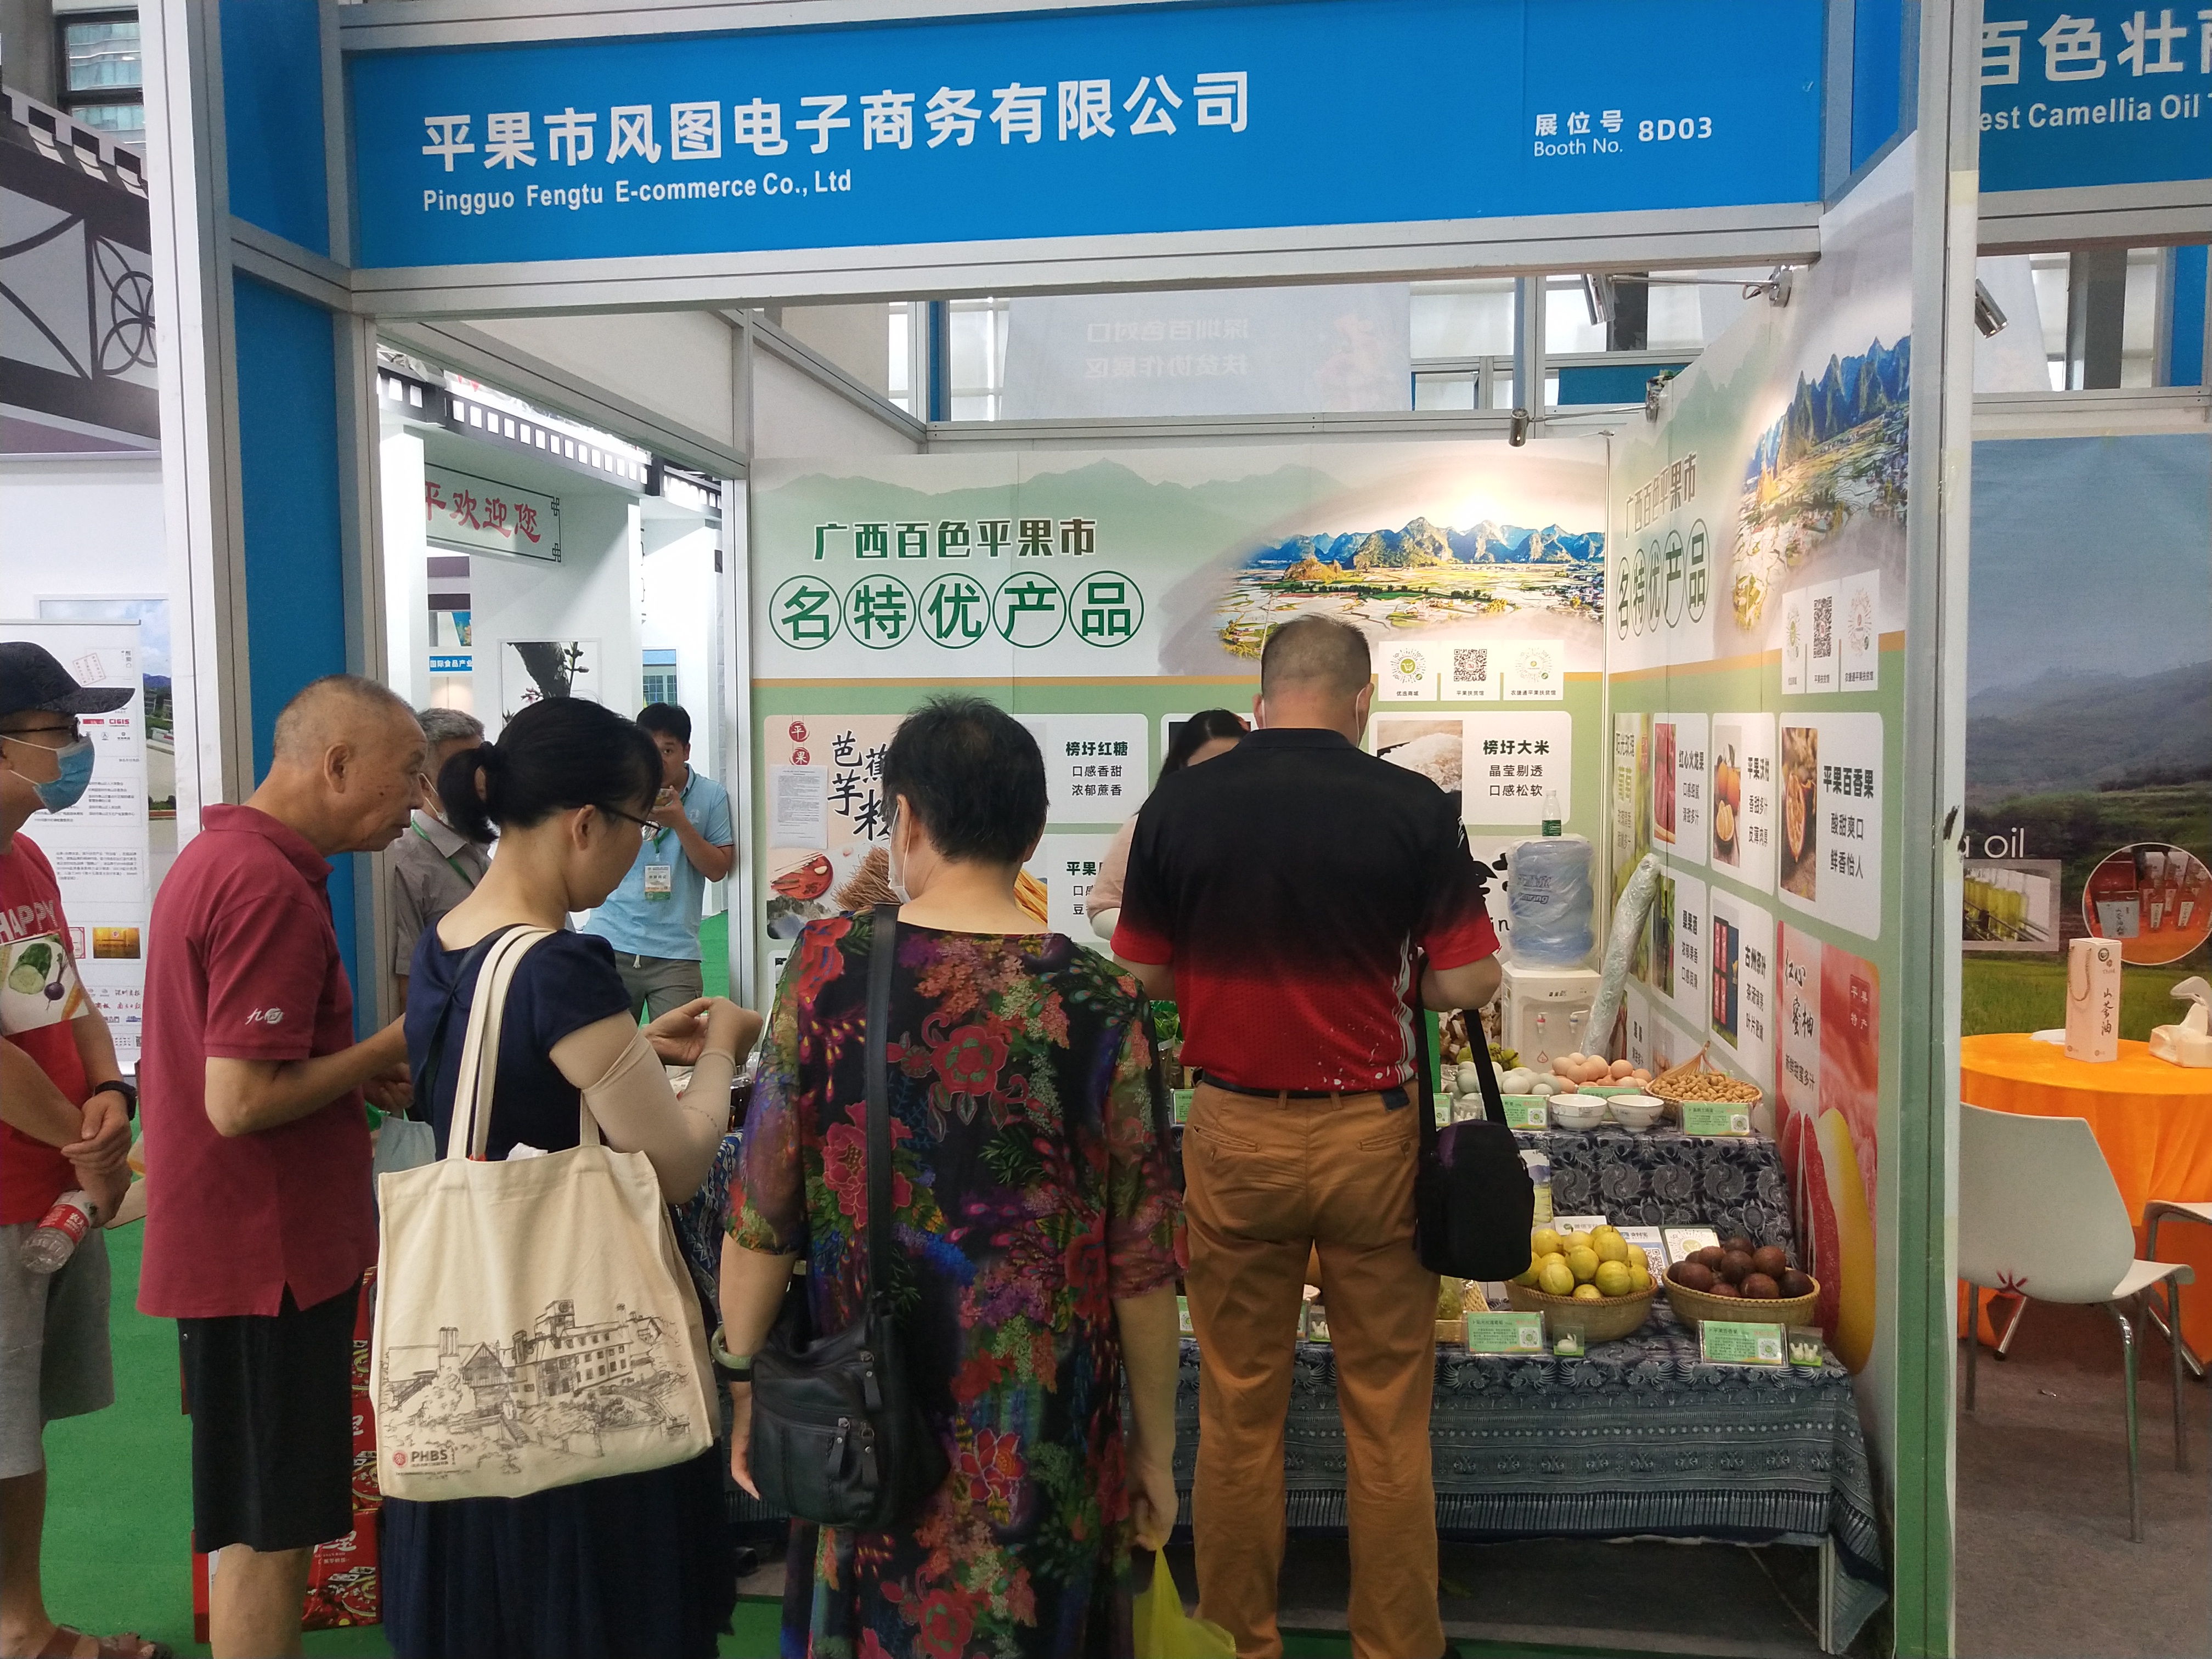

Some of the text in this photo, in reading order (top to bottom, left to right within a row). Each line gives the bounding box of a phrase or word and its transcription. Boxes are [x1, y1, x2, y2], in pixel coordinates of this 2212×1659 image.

[422, 71, 1248, 172] 平果市风图电子商务有限公司
[1535, 109, 1624, 137] 展位号
[2028, 97, 2152, 128] Camellia
[2160, 94, 2199, 120] Oil
[1638, 117, 1713, 142] 8D03
[1534, 138, 1623, 156] Booth No.
[424, 169, 851, 215] Pingguo Fengtu E-commerce Co., Ltd
[1625, 451, 1697, 539] 广西百色平果市
[814, 518, 1097, 560] 广西百色平果市
[1618, 532, 1705, 630] 名特优产品
[781, 581, 1131, 641] 名特优产品
[1065, 741, 1128, 756] 榜圩红糖
[1483, 740, 1550, 755] 榜圩大米
[1072, 765, 1122, 777] 口感香甜
[1489, 764, 1543, 777] 晶莹剔透
[1823, 765, 1874, 799] 平果百香果
[1071, 784, 1122, 796] 浓郁蔗香
[1489, 784, 1543, 797] 口感松软
[1831, 812, 1864, 840] 酸甜爽口
[1984, 827, 2024, 859] oil
[1066, 861, 1103, 876] 平果
[1830, 849, 1864, 879] 鲜香怡人
[1785, 949, 1807, 988] 红心
[1850, 985, 1869, 1005] 平果
[1792, 994, 1814, 1039] 蜜柚
[1850, 1013, 1869, 1029] 特产
[2100, 988, 2115, 1036] 山茶油
[411, 1449, 448, 1462] PHBS
